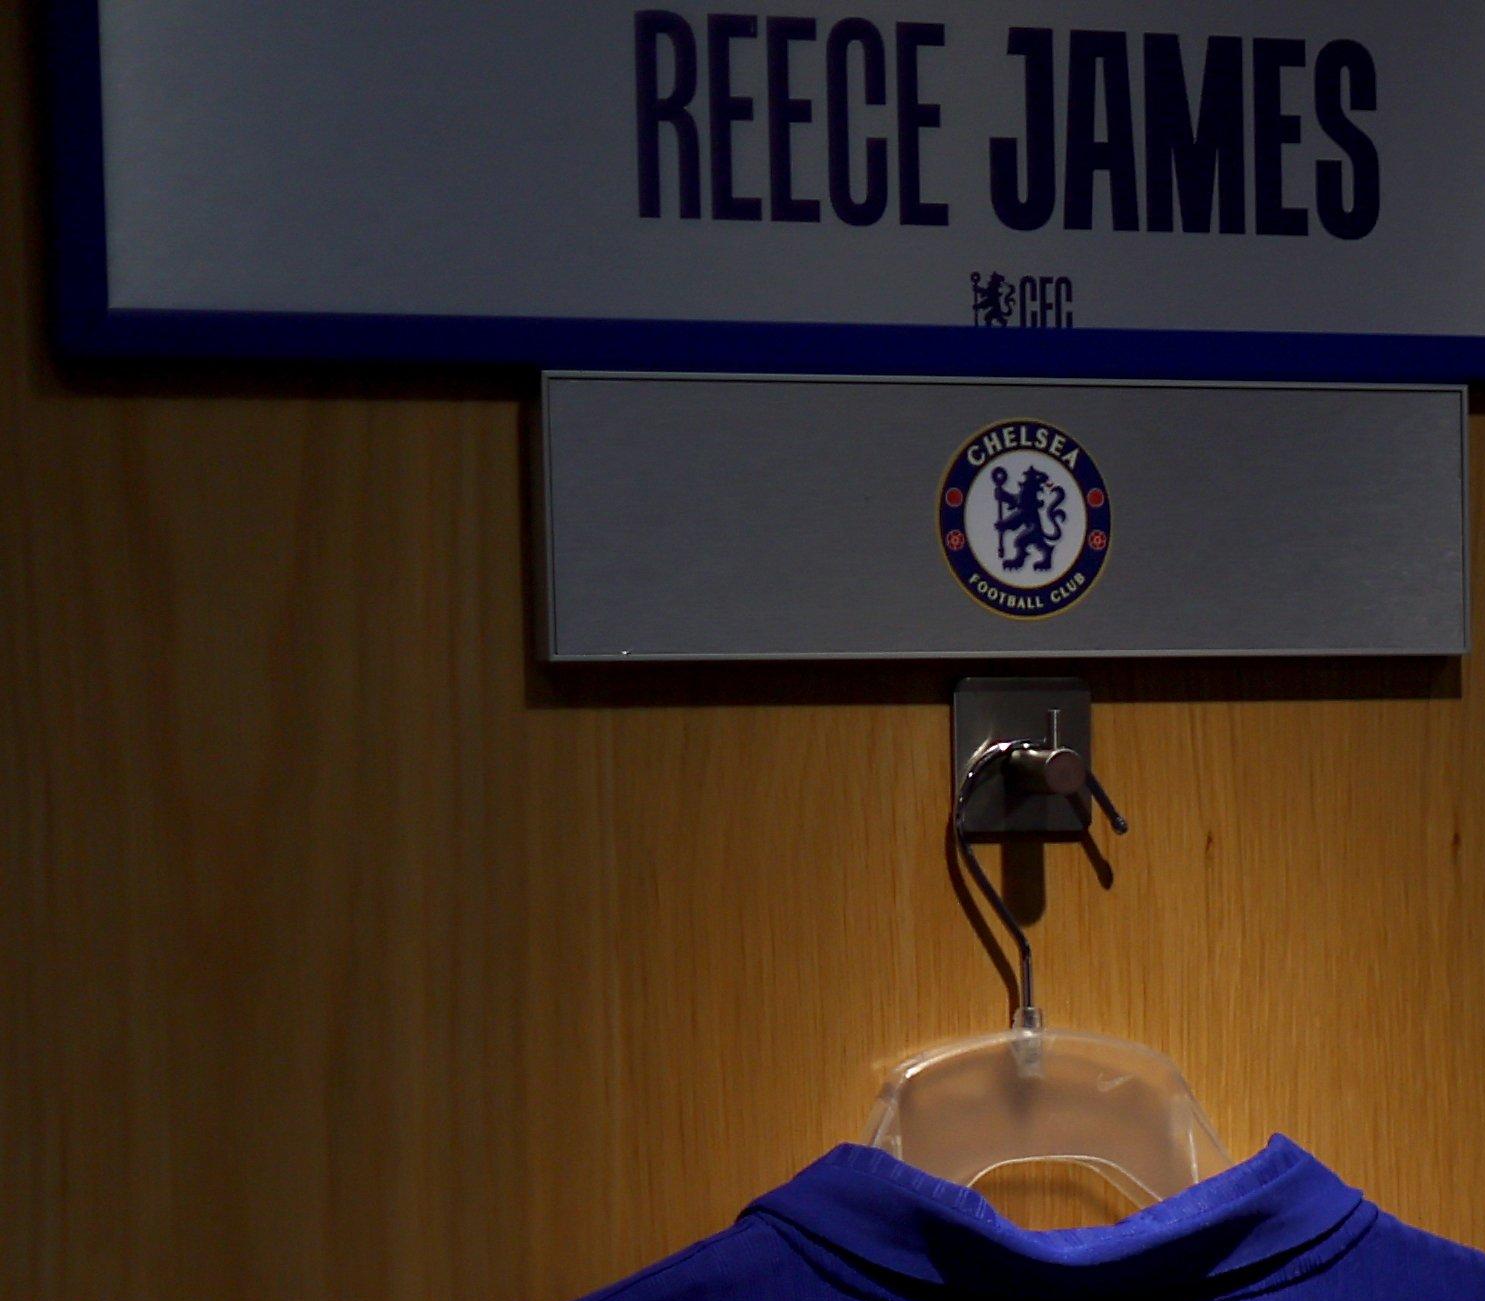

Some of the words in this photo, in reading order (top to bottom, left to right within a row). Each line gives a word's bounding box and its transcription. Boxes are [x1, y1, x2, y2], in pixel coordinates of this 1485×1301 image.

[633, 8, 949, 227] REECE
[989, 26, 1380, 241] JAMES
[1019, 275, 1073, 329] CFC
[966, 425, 1079, 470] CHELSEA
[968, 573, 1045, 610] FOOTBALL
[1051, 571, 1086, 602] CLUB
